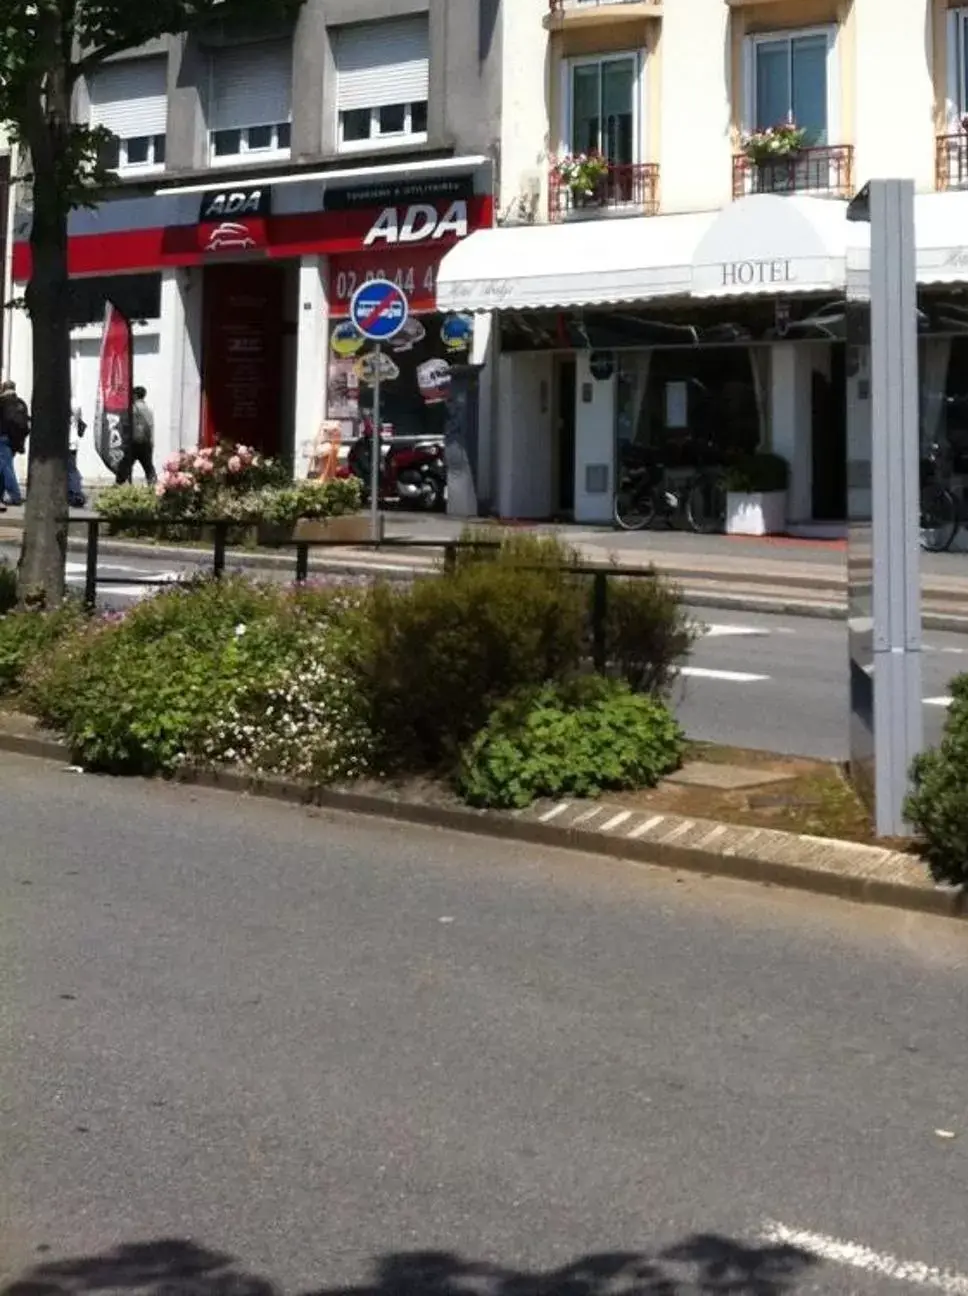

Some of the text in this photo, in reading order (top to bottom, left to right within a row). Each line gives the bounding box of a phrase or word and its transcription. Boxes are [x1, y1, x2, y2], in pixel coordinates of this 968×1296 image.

[205, 190, 261, 215] ADA
[363, 200, 467, 245] ADA
[336, 271, 357, 298] 02
[721, 259, 798, 286] HOTEL
